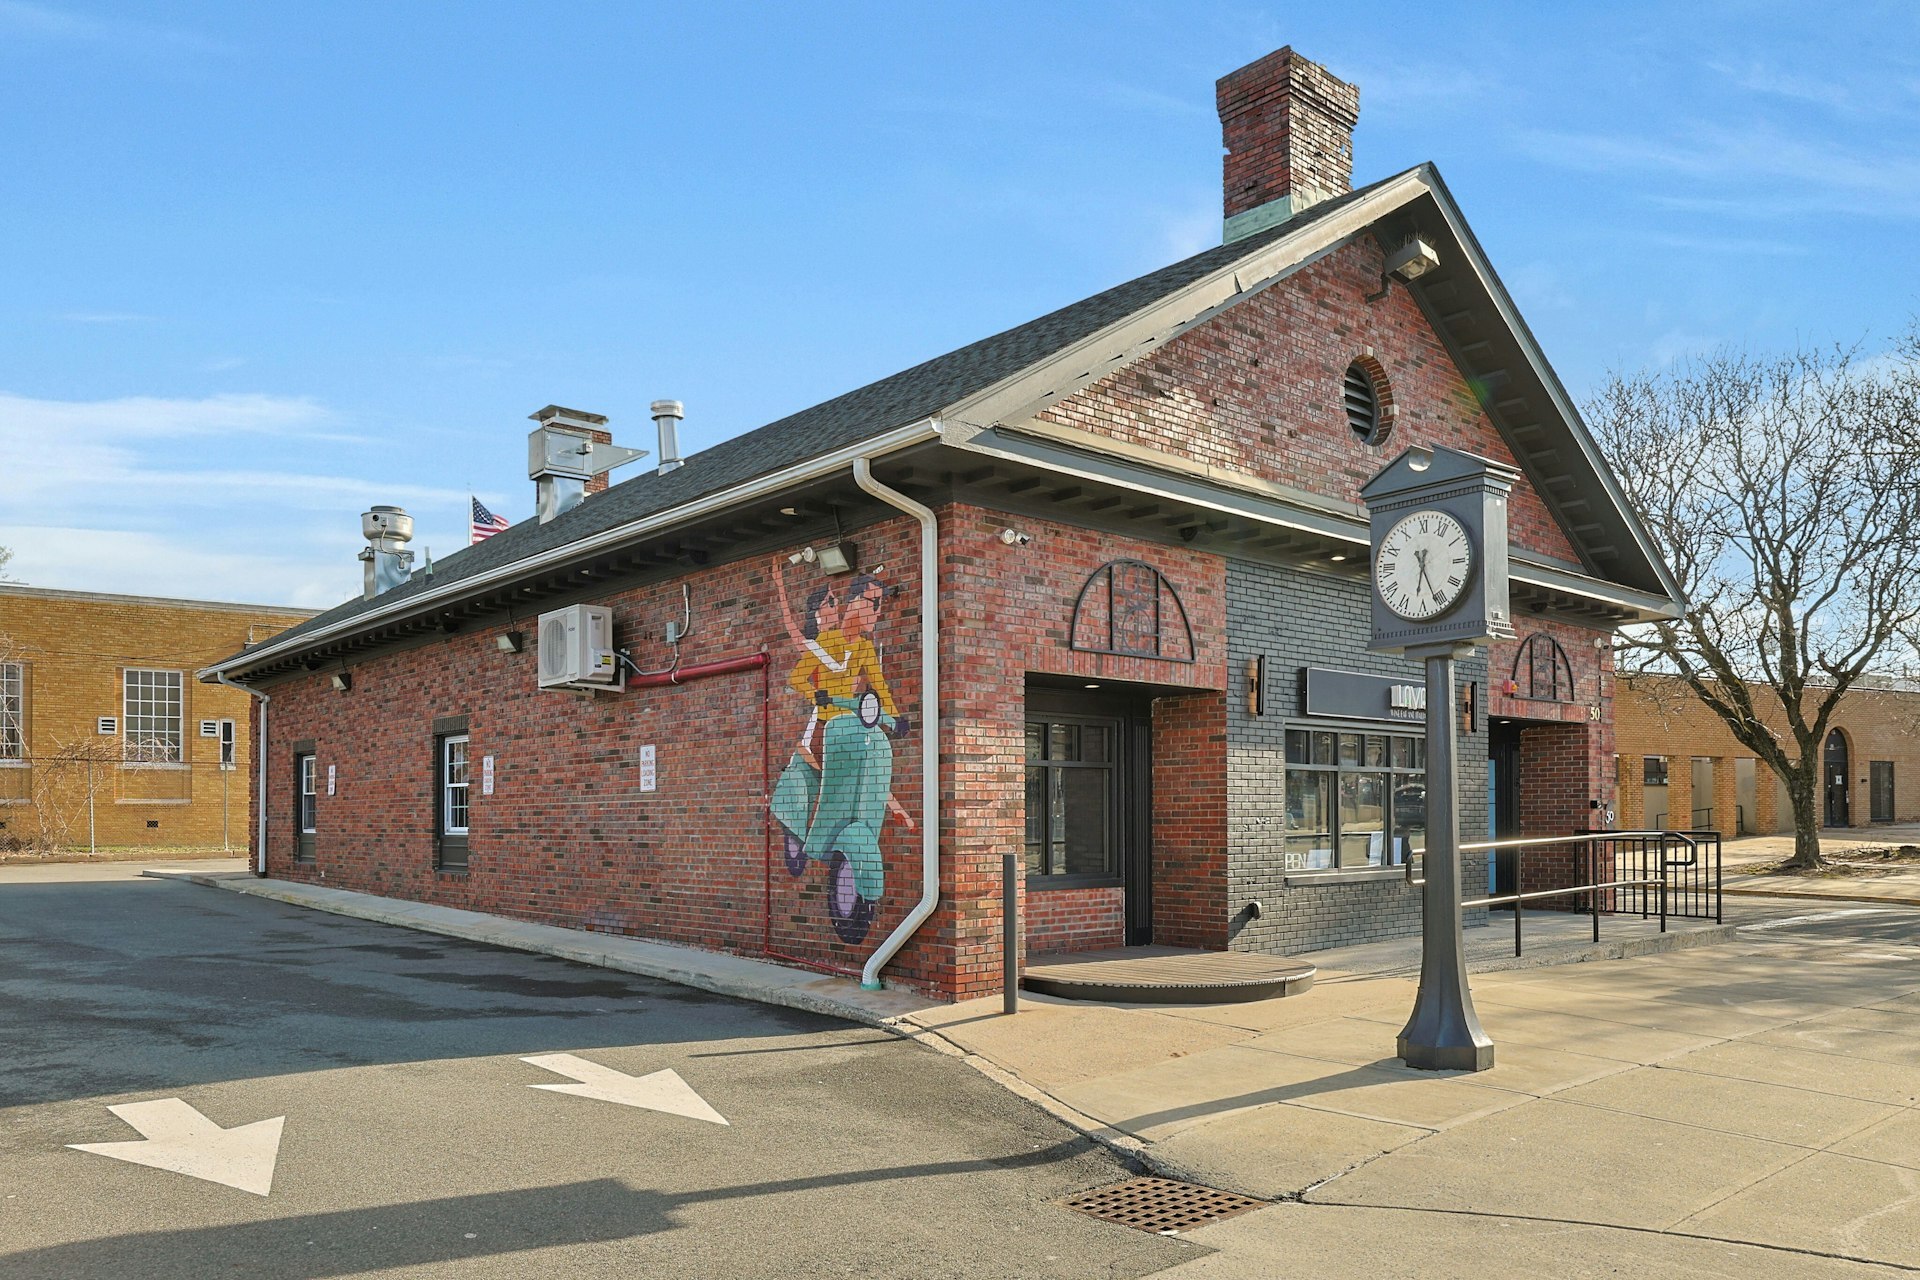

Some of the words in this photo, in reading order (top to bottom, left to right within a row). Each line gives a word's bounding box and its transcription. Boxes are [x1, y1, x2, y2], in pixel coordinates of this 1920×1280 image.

[1401, 527, 1412, 542] X
[1590, 706, 1600, 720] 50
[1285, 853, 1307, 870] PEN
